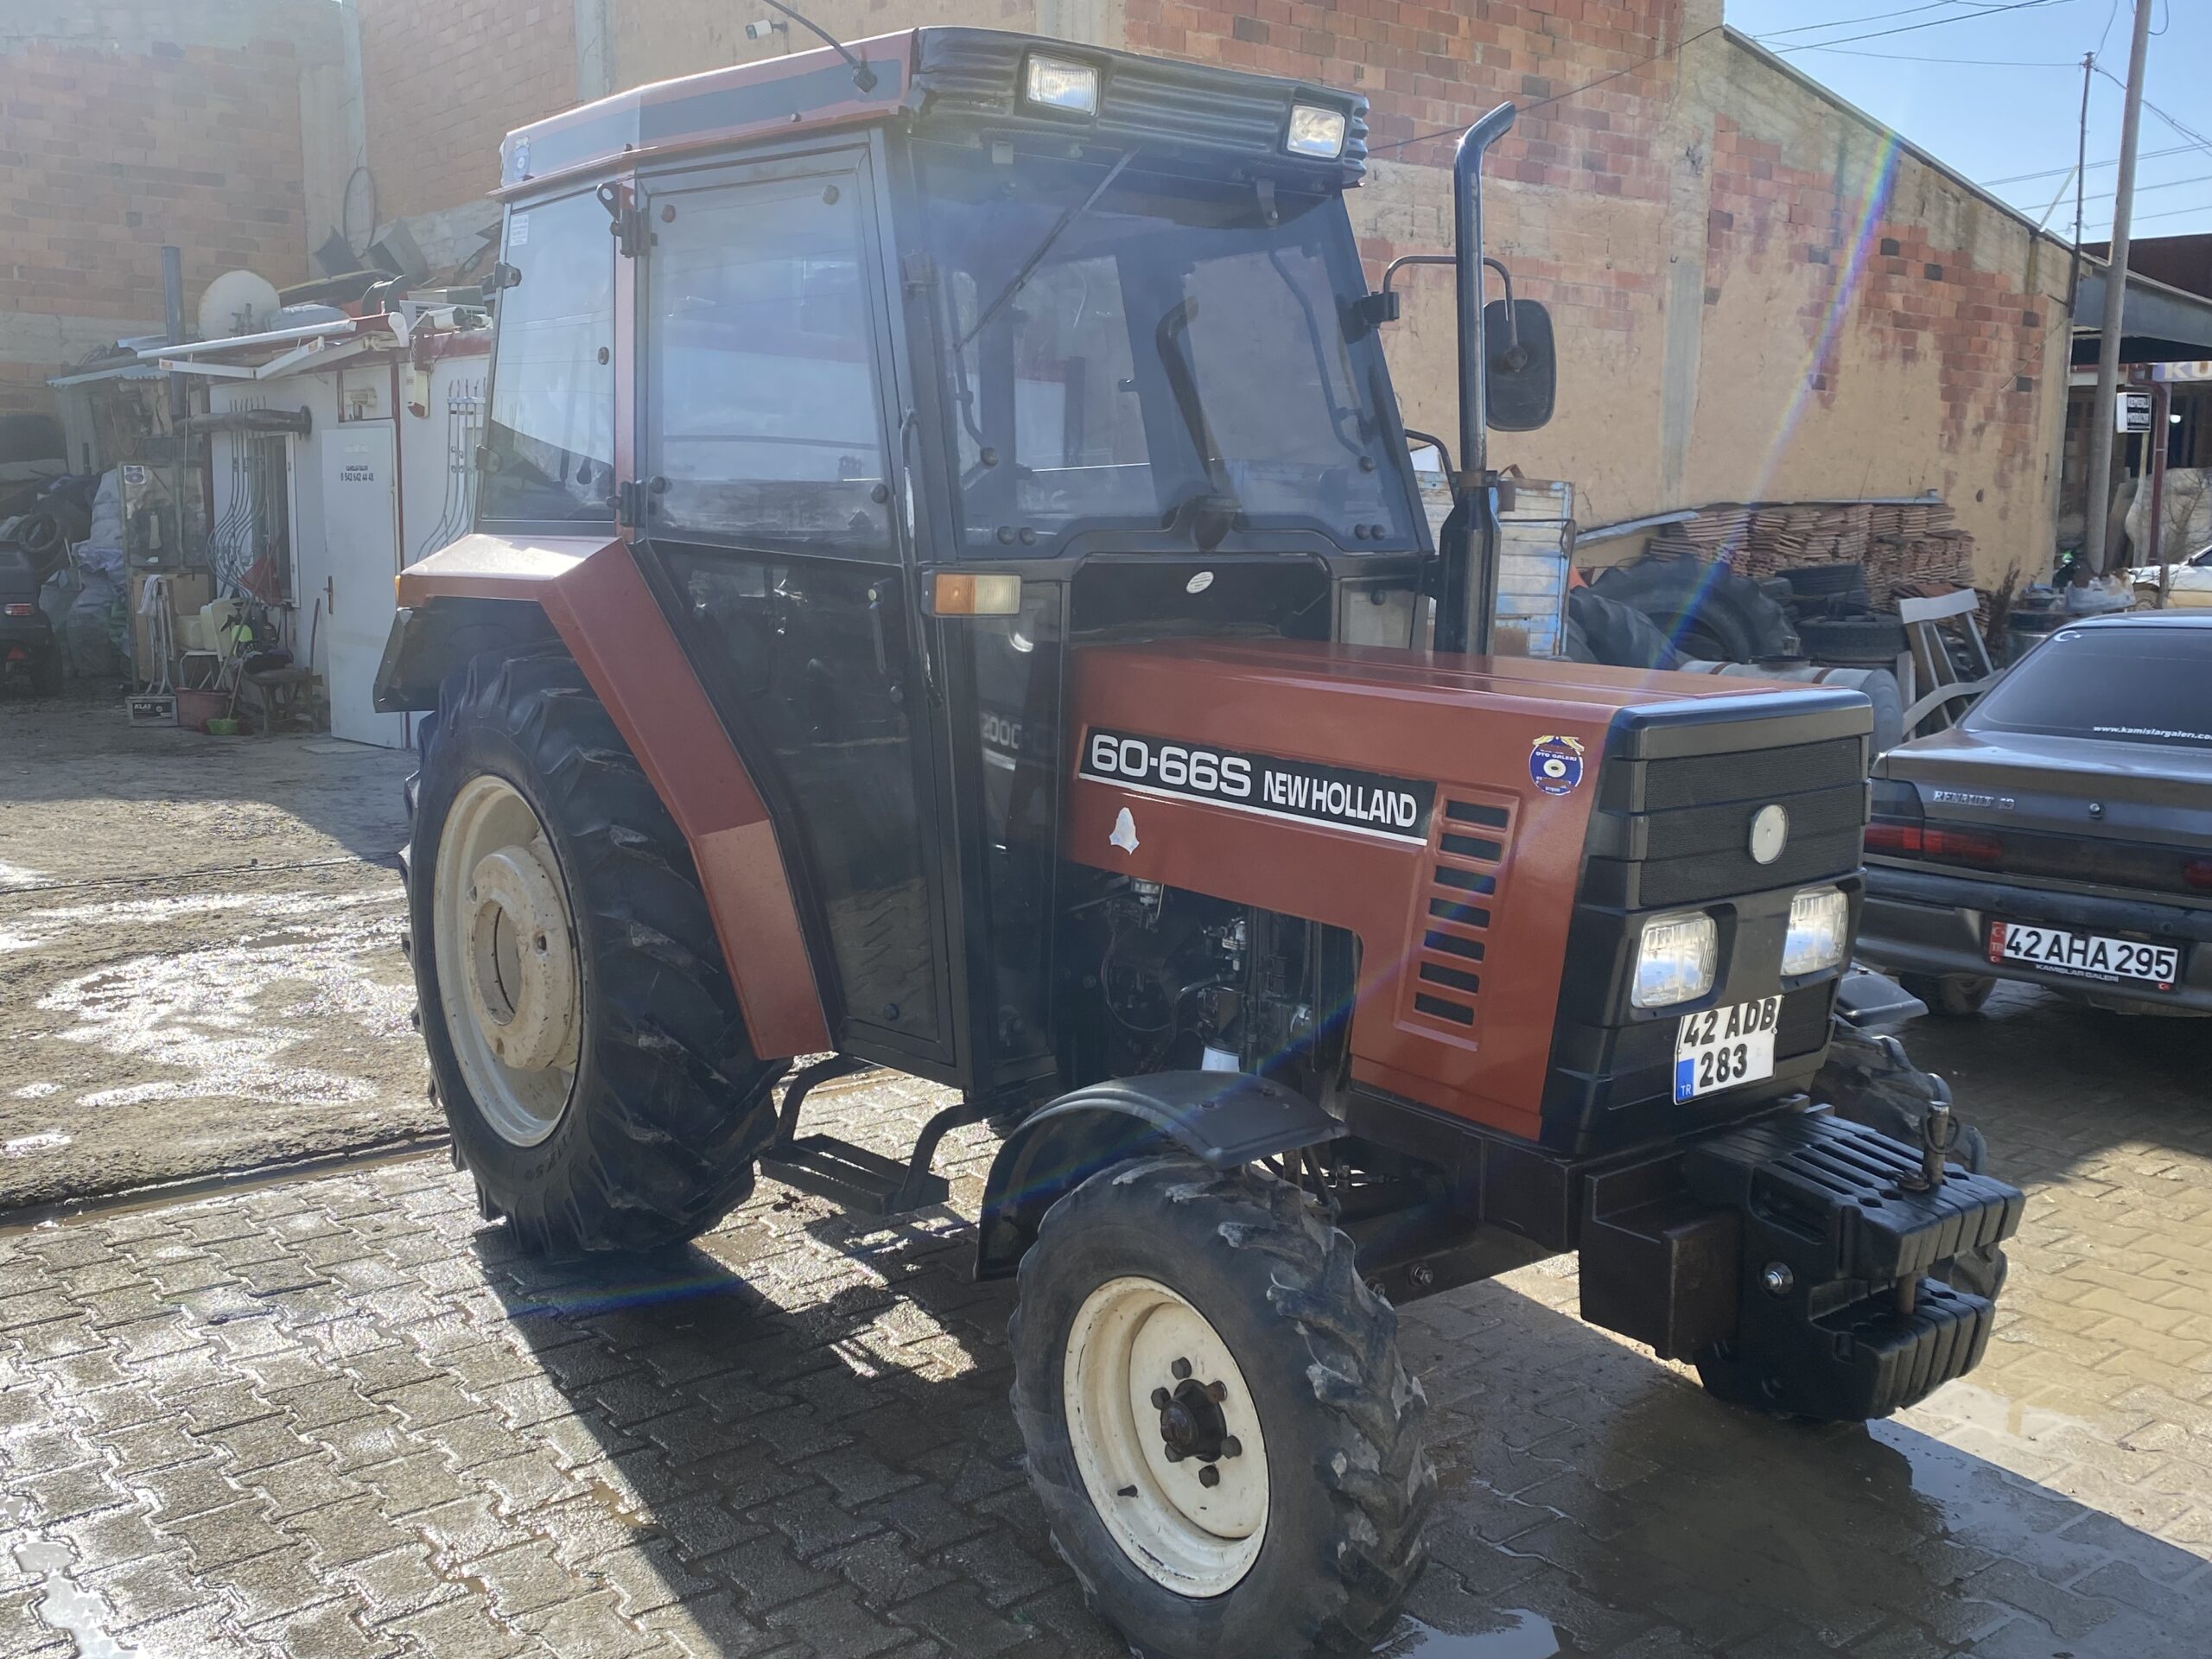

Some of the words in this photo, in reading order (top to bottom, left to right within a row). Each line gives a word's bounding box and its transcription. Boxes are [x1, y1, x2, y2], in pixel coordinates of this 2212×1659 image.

[1091, 734, 1253, 798] 60-66S
[1933, 790, 1994, 807] RENAULT
[1683, 1010, 1719, 1047] 42
[1725, 997, 1777, 1039] ADB
[1700, 1043, 1748, 1088] 283
[1681, 1084, 1692, 1096] TR
